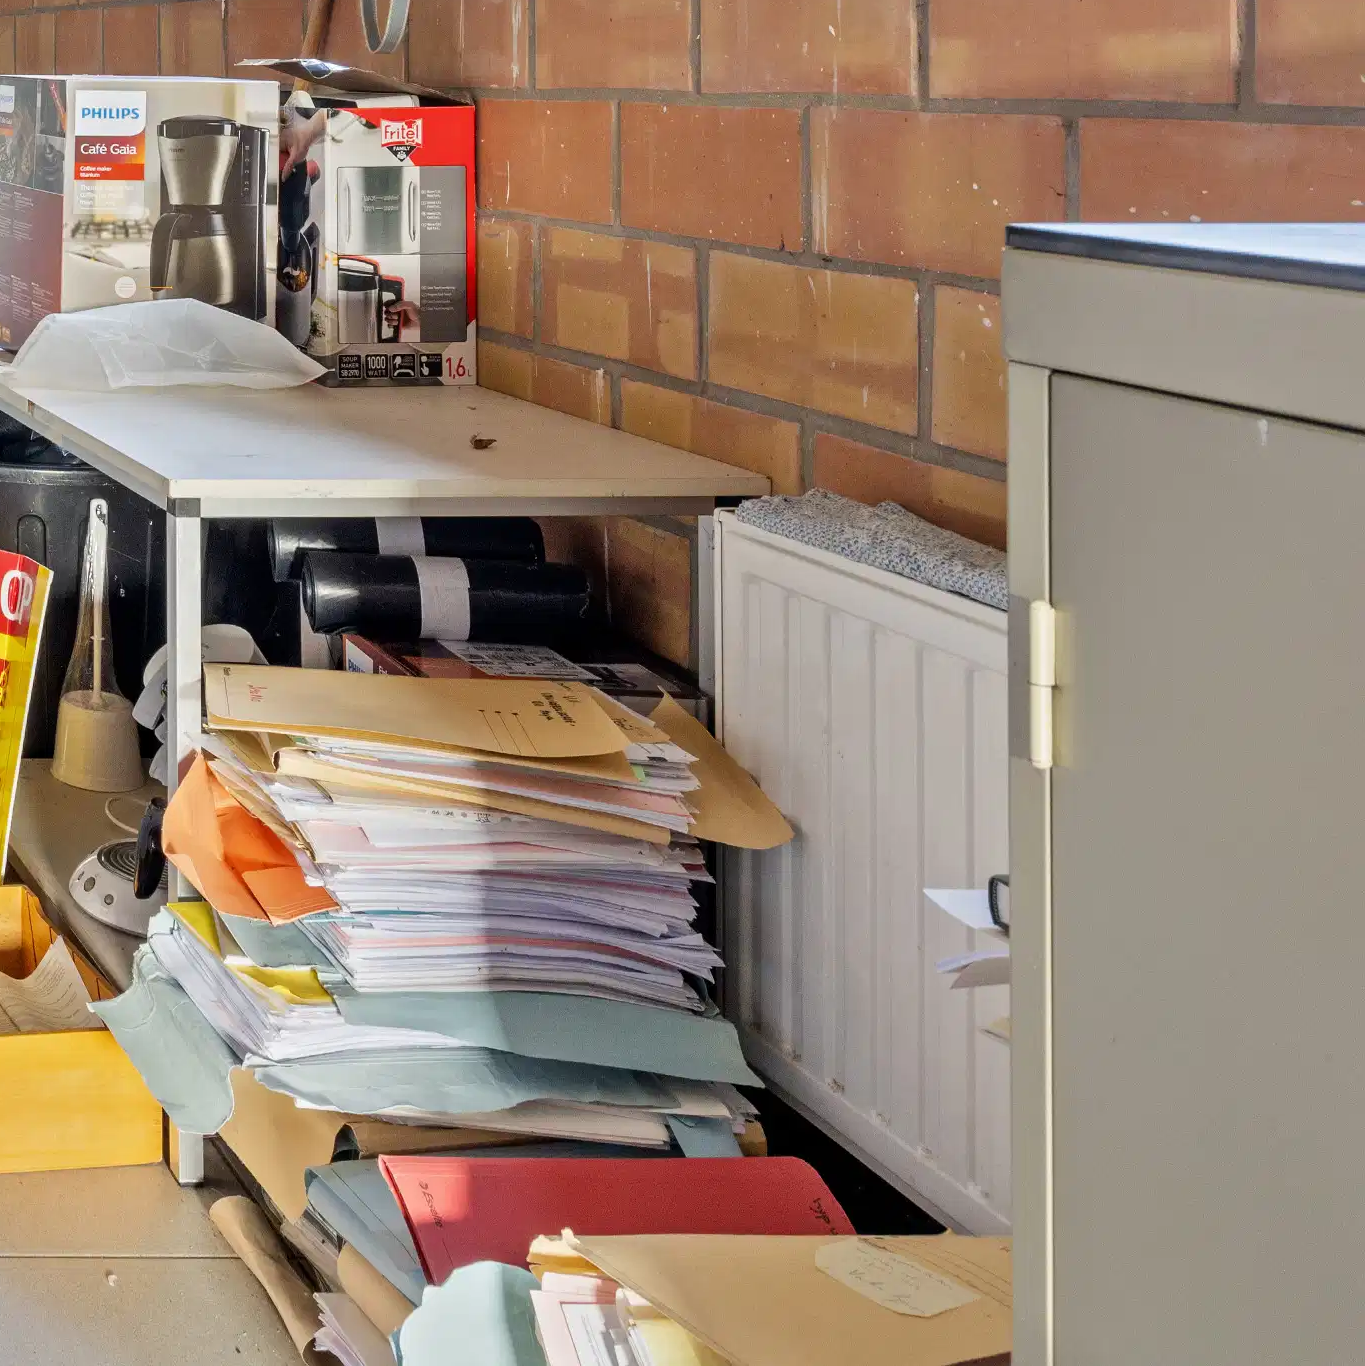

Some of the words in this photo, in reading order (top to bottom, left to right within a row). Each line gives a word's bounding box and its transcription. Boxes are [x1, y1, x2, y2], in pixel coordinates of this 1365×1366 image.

[81, 107, 140, 120] PHILIPS
[80, 143, 107, 154] Café
[110, 144, 137, 154] Gaia
[367, 356, 386, 369] 1000
[445, 356, 466, 379] 1,6
